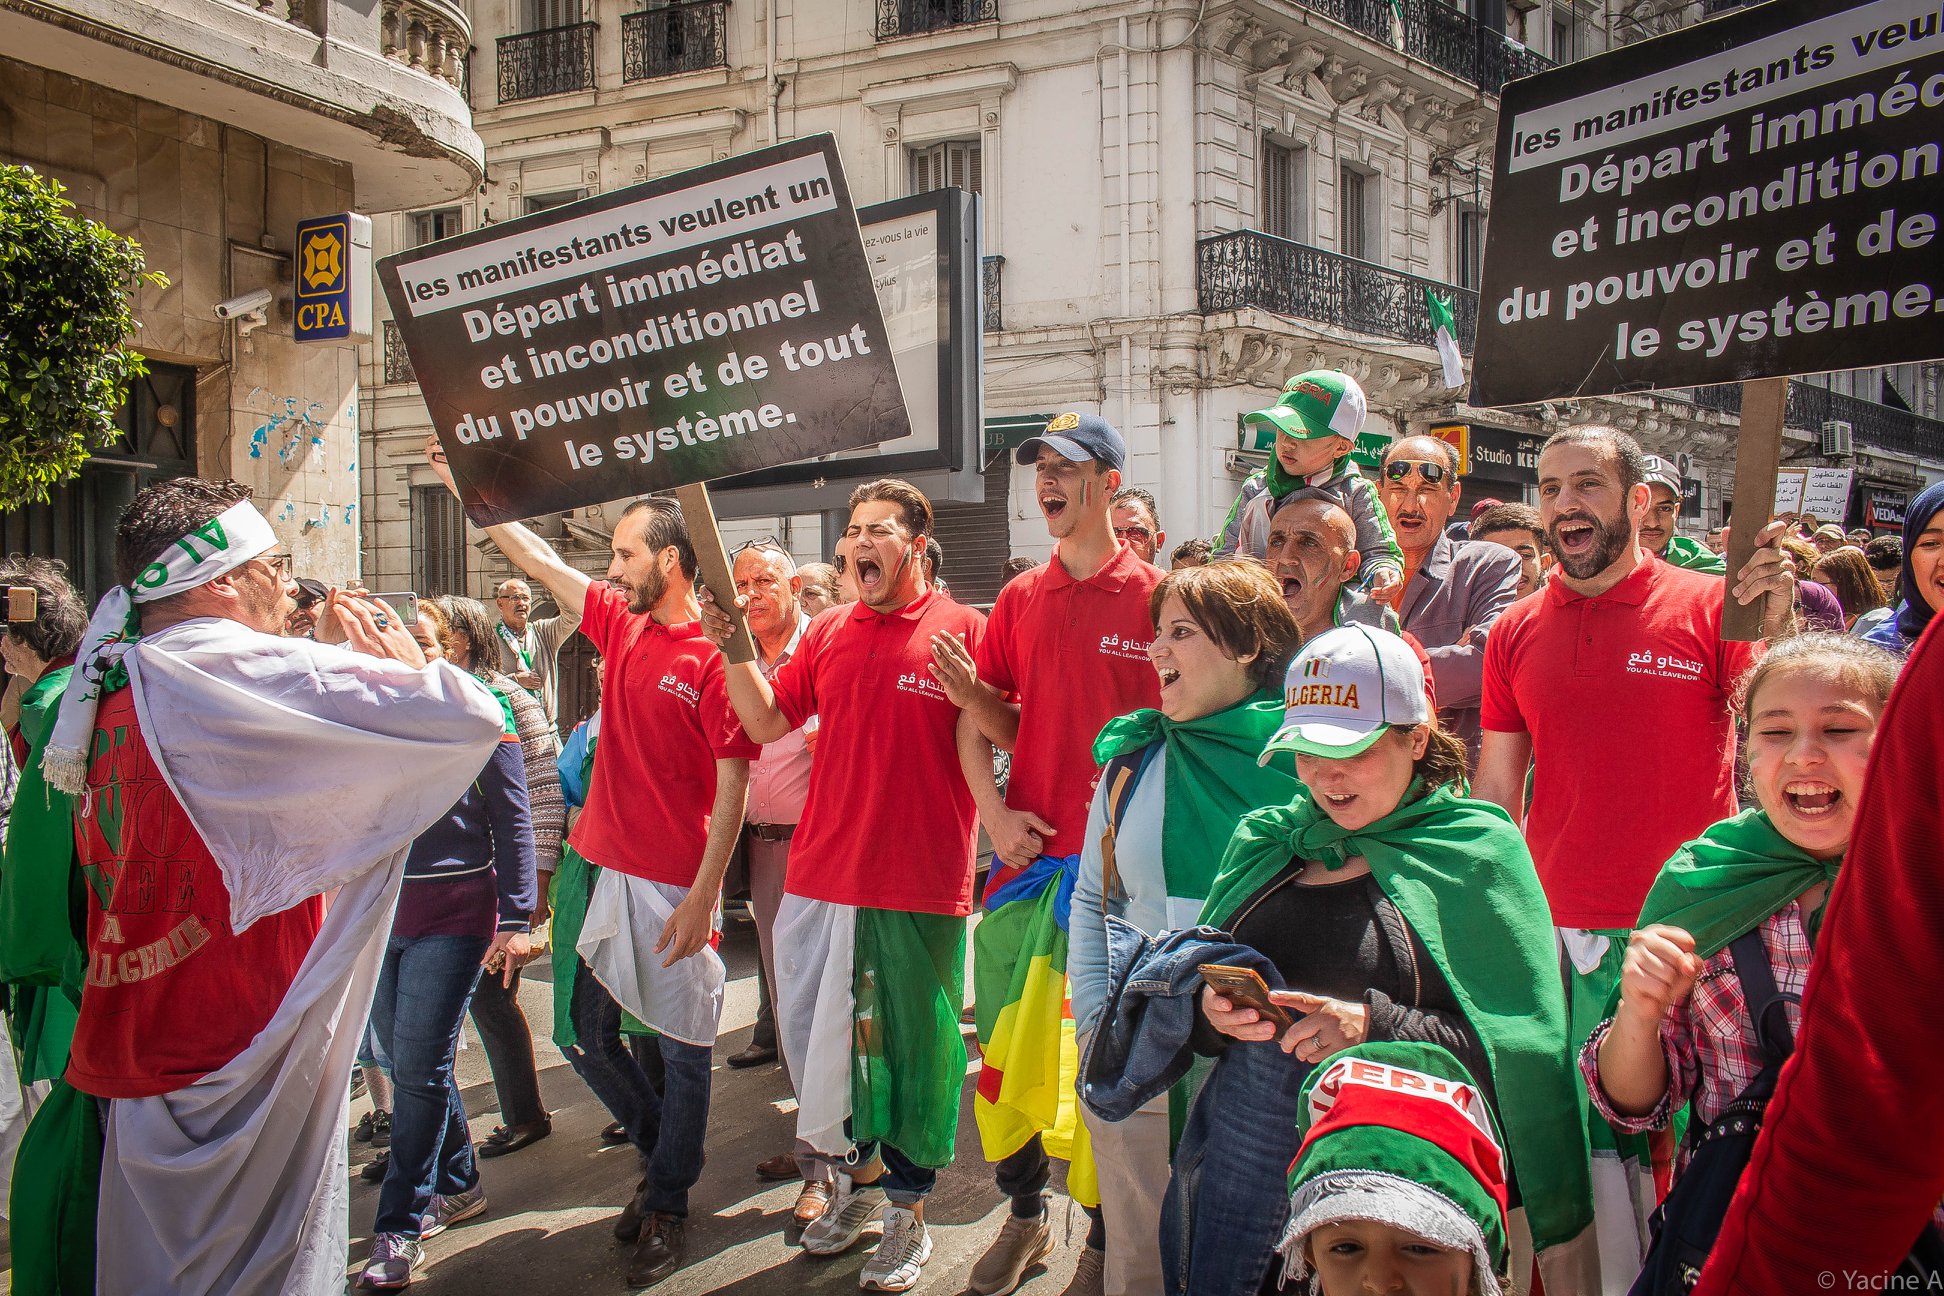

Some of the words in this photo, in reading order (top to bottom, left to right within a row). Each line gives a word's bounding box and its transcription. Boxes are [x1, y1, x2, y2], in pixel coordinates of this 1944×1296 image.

[1514, 131, 1560, 157] les
[1572, 42, 1835, 140] manifestants
[1560, 124, 1730, 202] Départ
[863, 232, 902, 248] ez-vous
[904, 228, 913, 239] la
[914, 225, 929, 236] vie
[1552, 216, 1598, 258] et
[1615, 142, 1939, 245] incondition
[404, 274, 450, 304] les
[458, 220, 651, 292] manifestants
[659, 185, 778, 236] veulent
[788, 173, 830, 203] un
[1498, 286, 1549, 324] du
[1566, 244, 1759, 320] pouvoir
[1776, 222, 1836, 271] et
[1858, 209, 1936, 258] de
[297, 301, 346, 331] CPA
[463, 283, 600, 342] Départ
[606, 229, 807, 307] immédiat
[480, 354, 517, 390] et
[528, 280, 820, 379] inconditionnel
[1616, 322, 1660, 360] le
[455, 413, 501, 445] du
[511, 376, 650, 440] pouvoir
[664, 362, 707, 398] et
[718, 351, 768, 386] de
[780, 323, 871, 372] tout
[564, 439, 603, 470] le
[613, 402, 797, 464] système.
[1476, 446, 1512, 465] Studio
[657, 684, 667, 692] YOU
[1285, 683, 1360, 710] ALGERIA
[1658, 670, 1682, 679] LEAVE
